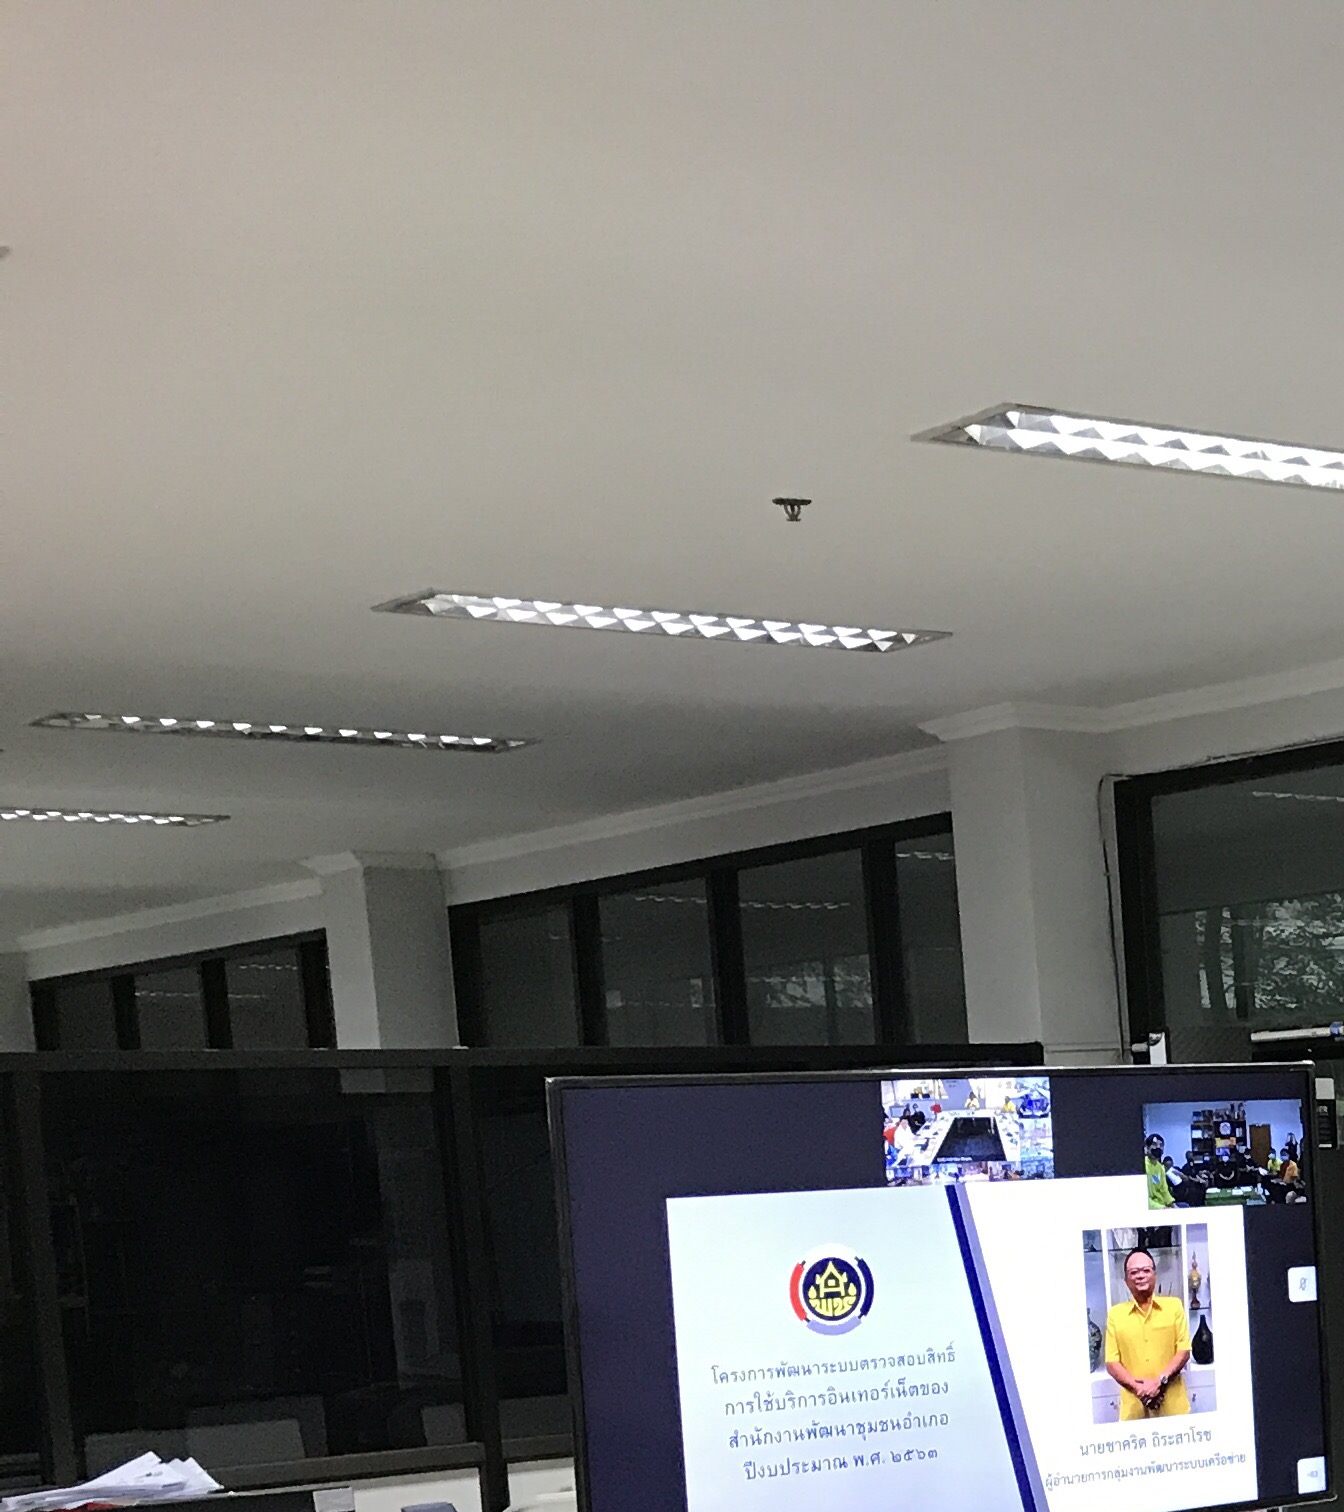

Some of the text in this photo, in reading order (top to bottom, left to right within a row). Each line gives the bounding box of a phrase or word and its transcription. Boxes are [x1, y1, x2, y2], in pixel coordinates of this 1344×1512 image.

[710, 1340, 957, 1385] โครงการพัฒนาระบบตรวจสอบสิทธิ์
[725, 1376, 950, 1416] การใช้บริการอินเทอร์เน็ตของ
[728, 1409, 950, 1449] สำนักงานพัฒนาชุมชนอำเภอ
[743, 1456, 848, 1481] ปีงบประมาณ
